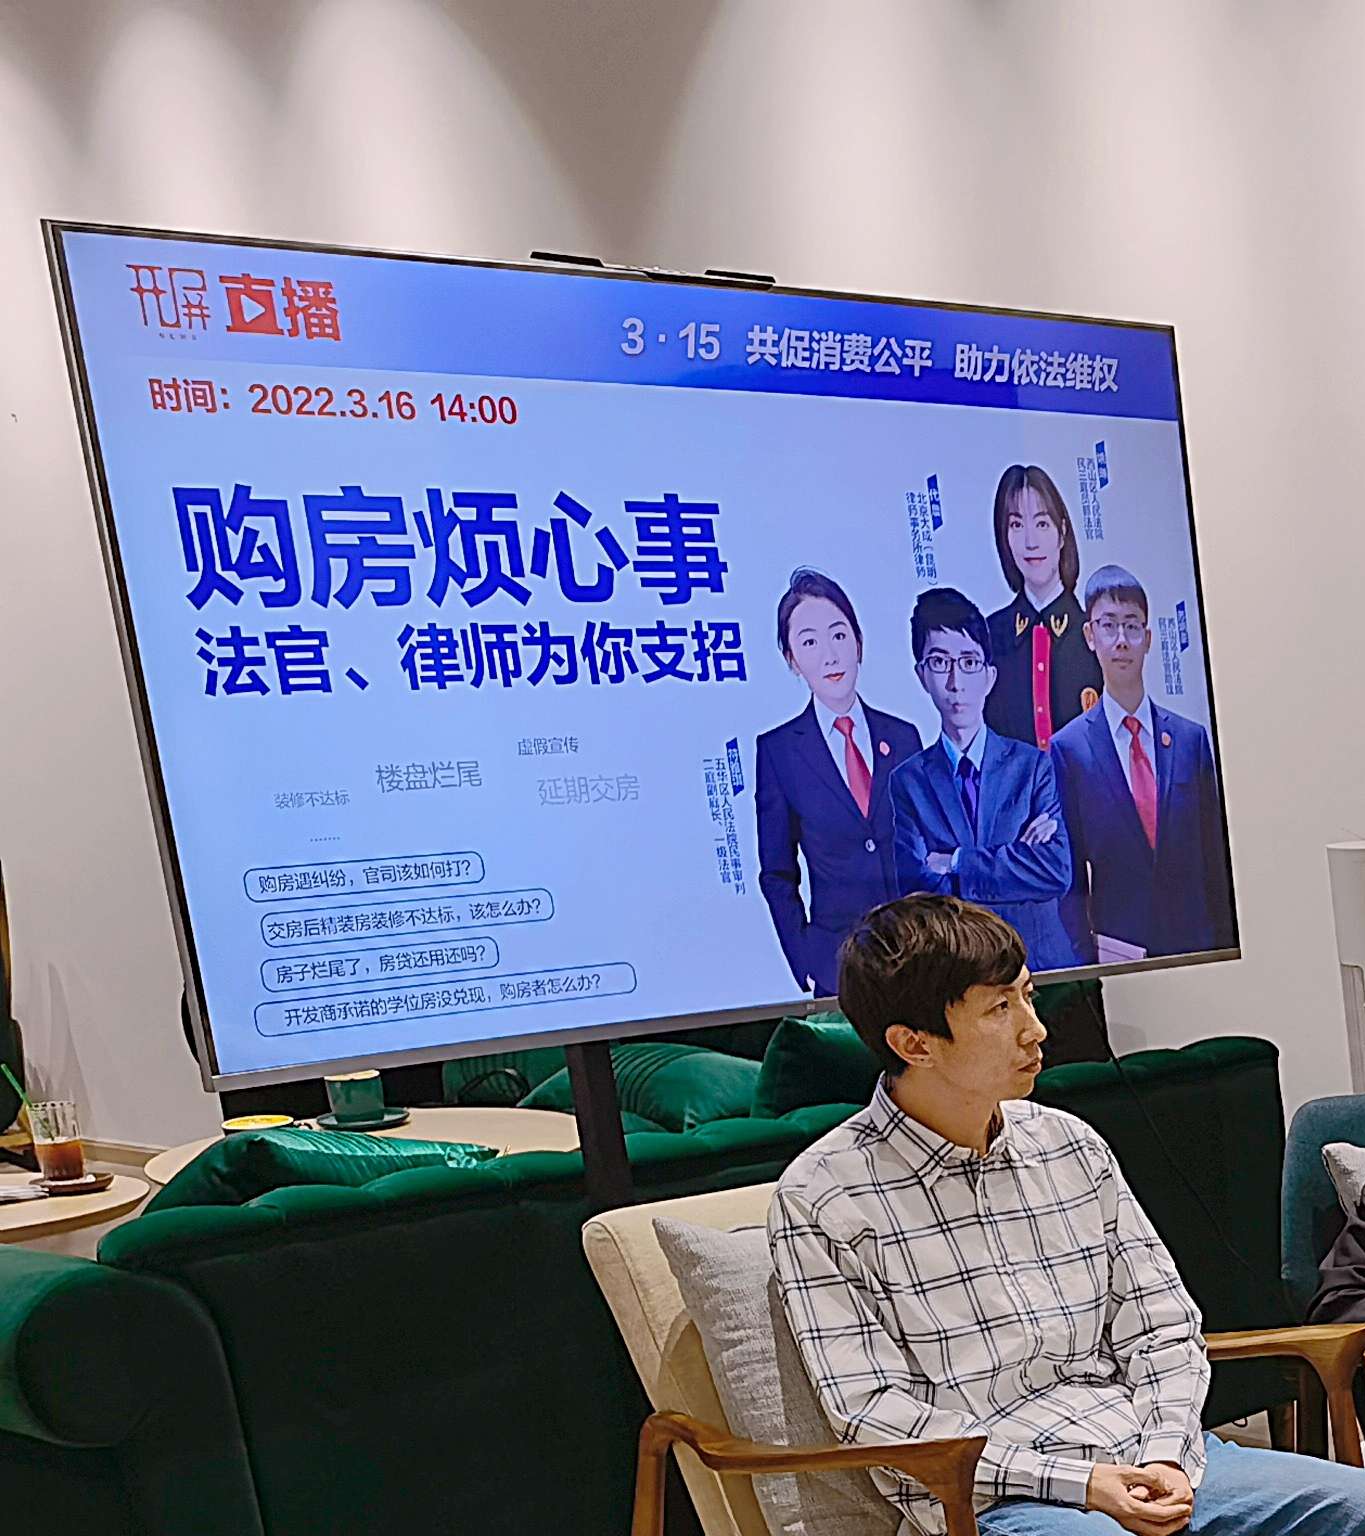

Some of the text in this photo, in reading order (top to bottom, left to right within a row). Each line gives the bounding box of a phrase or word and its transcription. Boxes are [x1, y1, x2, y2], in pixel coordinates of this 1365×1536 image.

[219, 273, 341, 341] 直播
[747, 325, 933, 375] 共促消费公平
[955, 343, 1119, 393] 助力依法维权
[249, 383, 416, 421] 2022.3.16
[431, 393, 518, 425] 14:00
[172, 483, 728, 610] 购房烦心事
[195, 620, 747, 697] 法官、律师为你支招
[517, 736, 579, 755] 虚假宣传
[375, 761, 482, 793] 楼盘烂尾
[537, 773, 640, 806] 延期交房
[274, 790, 350, 809] 装修不达标
